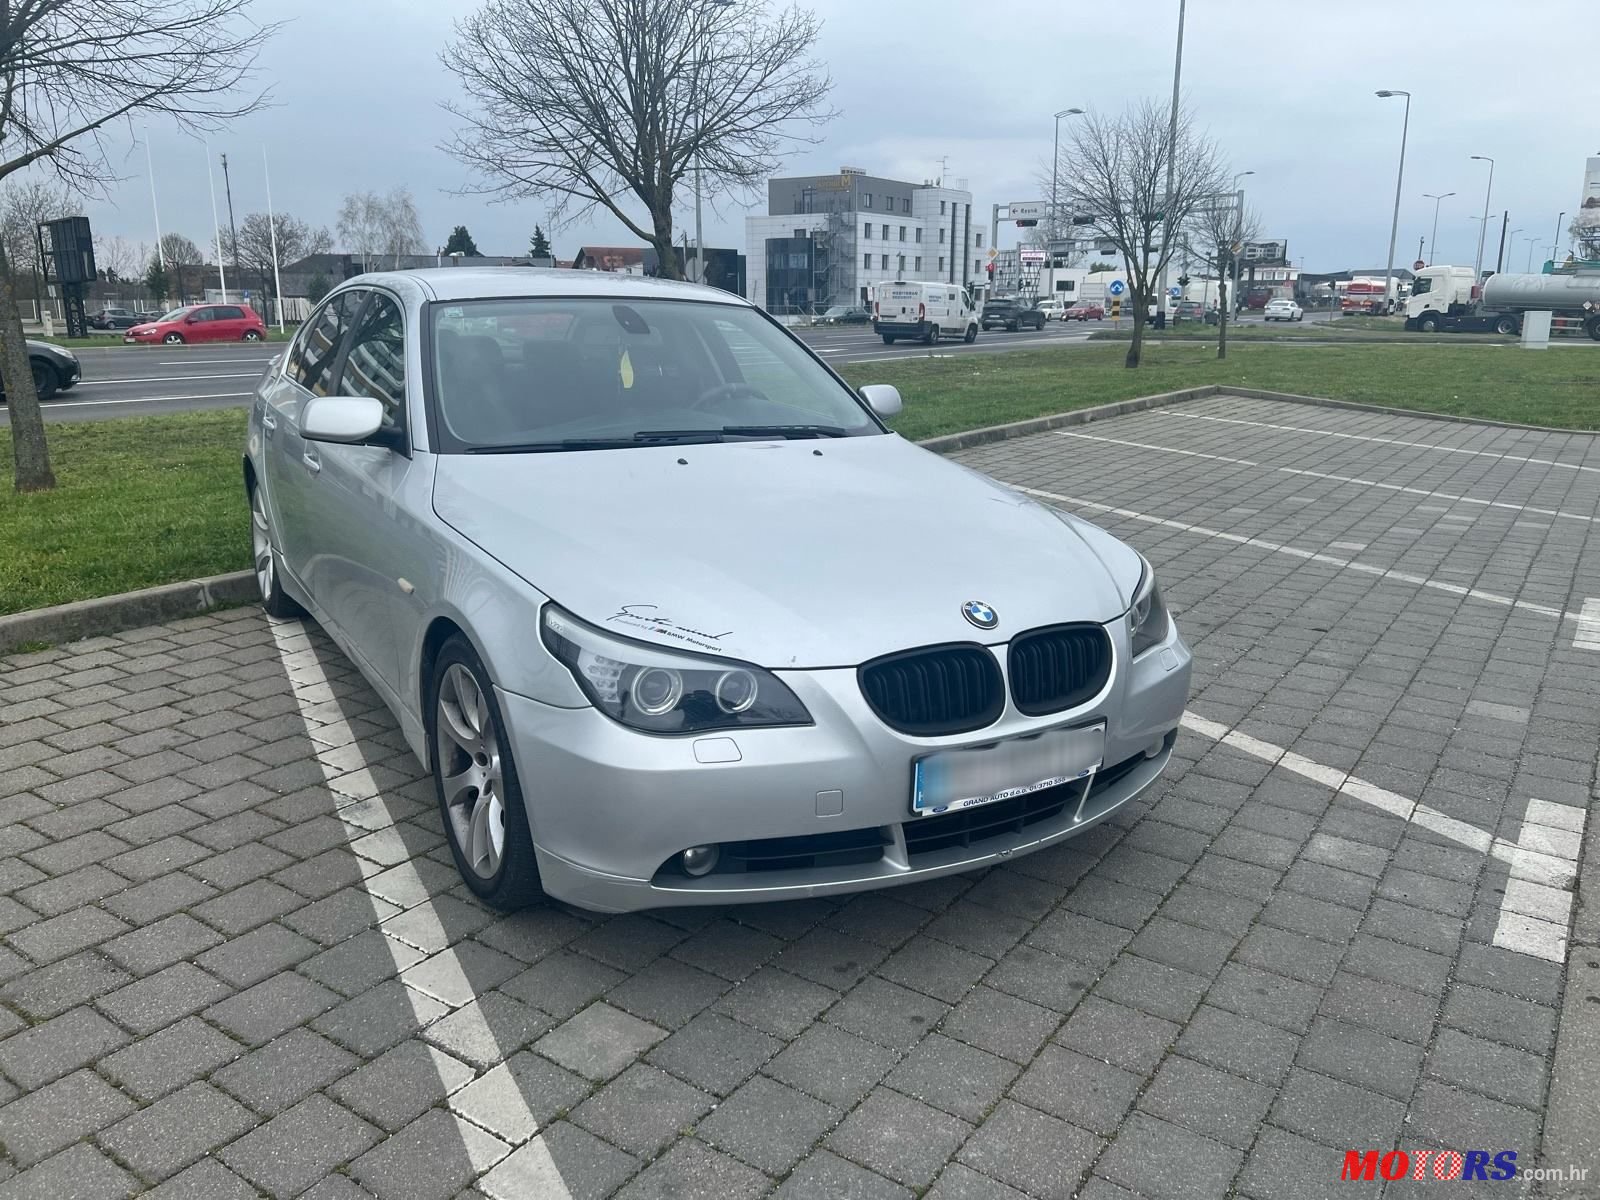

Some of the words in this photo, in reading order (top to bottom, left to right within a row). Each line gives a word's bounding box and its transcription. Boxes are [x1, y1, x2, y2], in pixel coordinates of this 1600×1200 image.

[686, 637, 722, 653] Motorsport
[963, 795, 989, 807] GRAND
[990, 791, 1009, 802] AUTO
